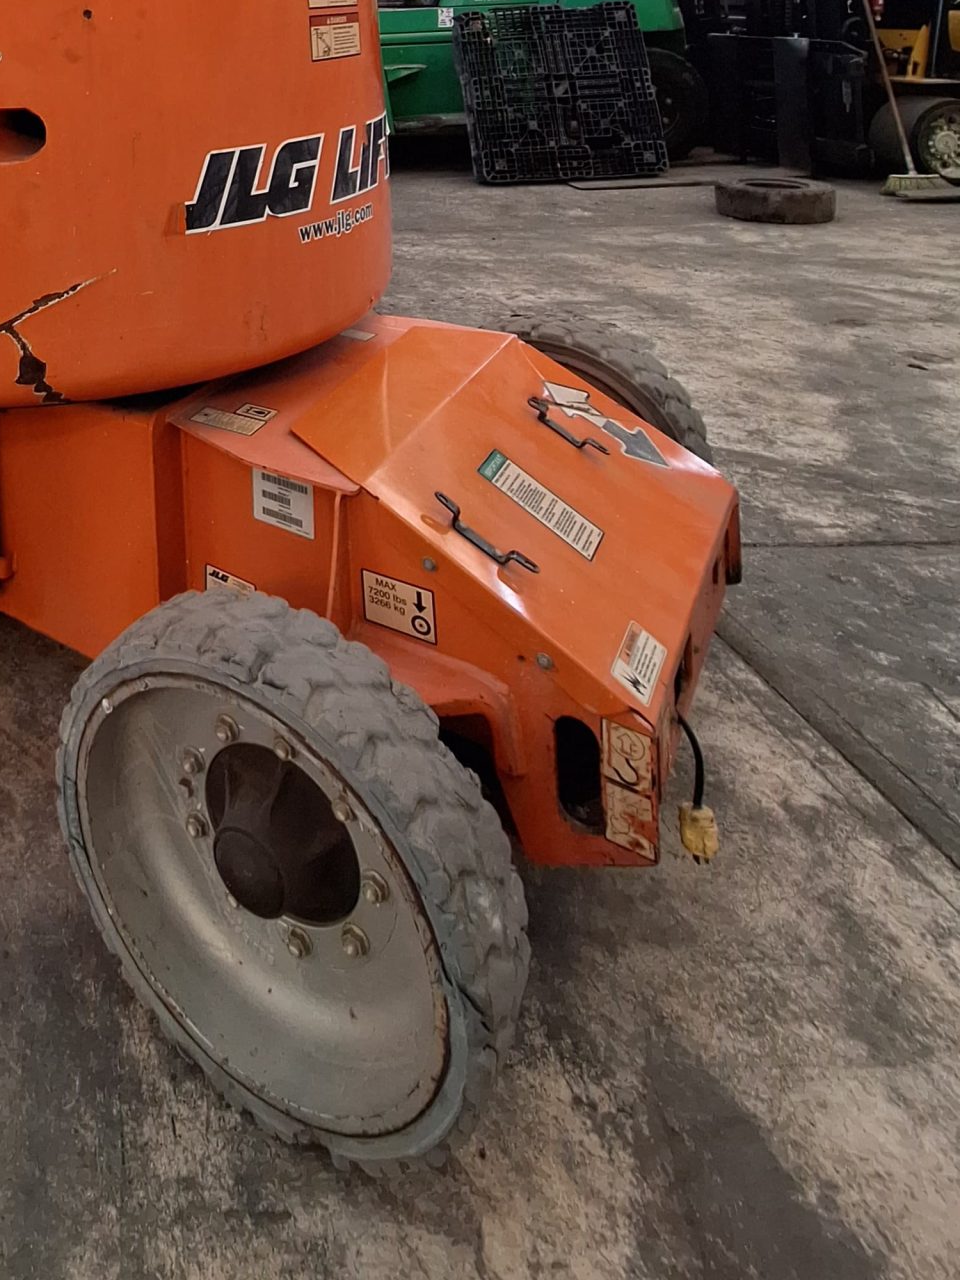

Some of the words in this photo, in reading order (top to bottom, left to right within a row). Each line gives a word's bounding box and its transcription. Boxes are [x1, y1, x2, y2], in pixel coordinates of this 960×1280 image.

[185, 133, 325, 235] JLG
[298, 204, 374, 243] www.jlg.com
[208, 569, 229, 583] JLG
[375, 577, 397, 592] MAX
[368, 585, 390, 600] 7200
[392, 593, 407, 606] lbs
[368, 595, 391, 609] 3266
[393, 603, 406, 616] kg
